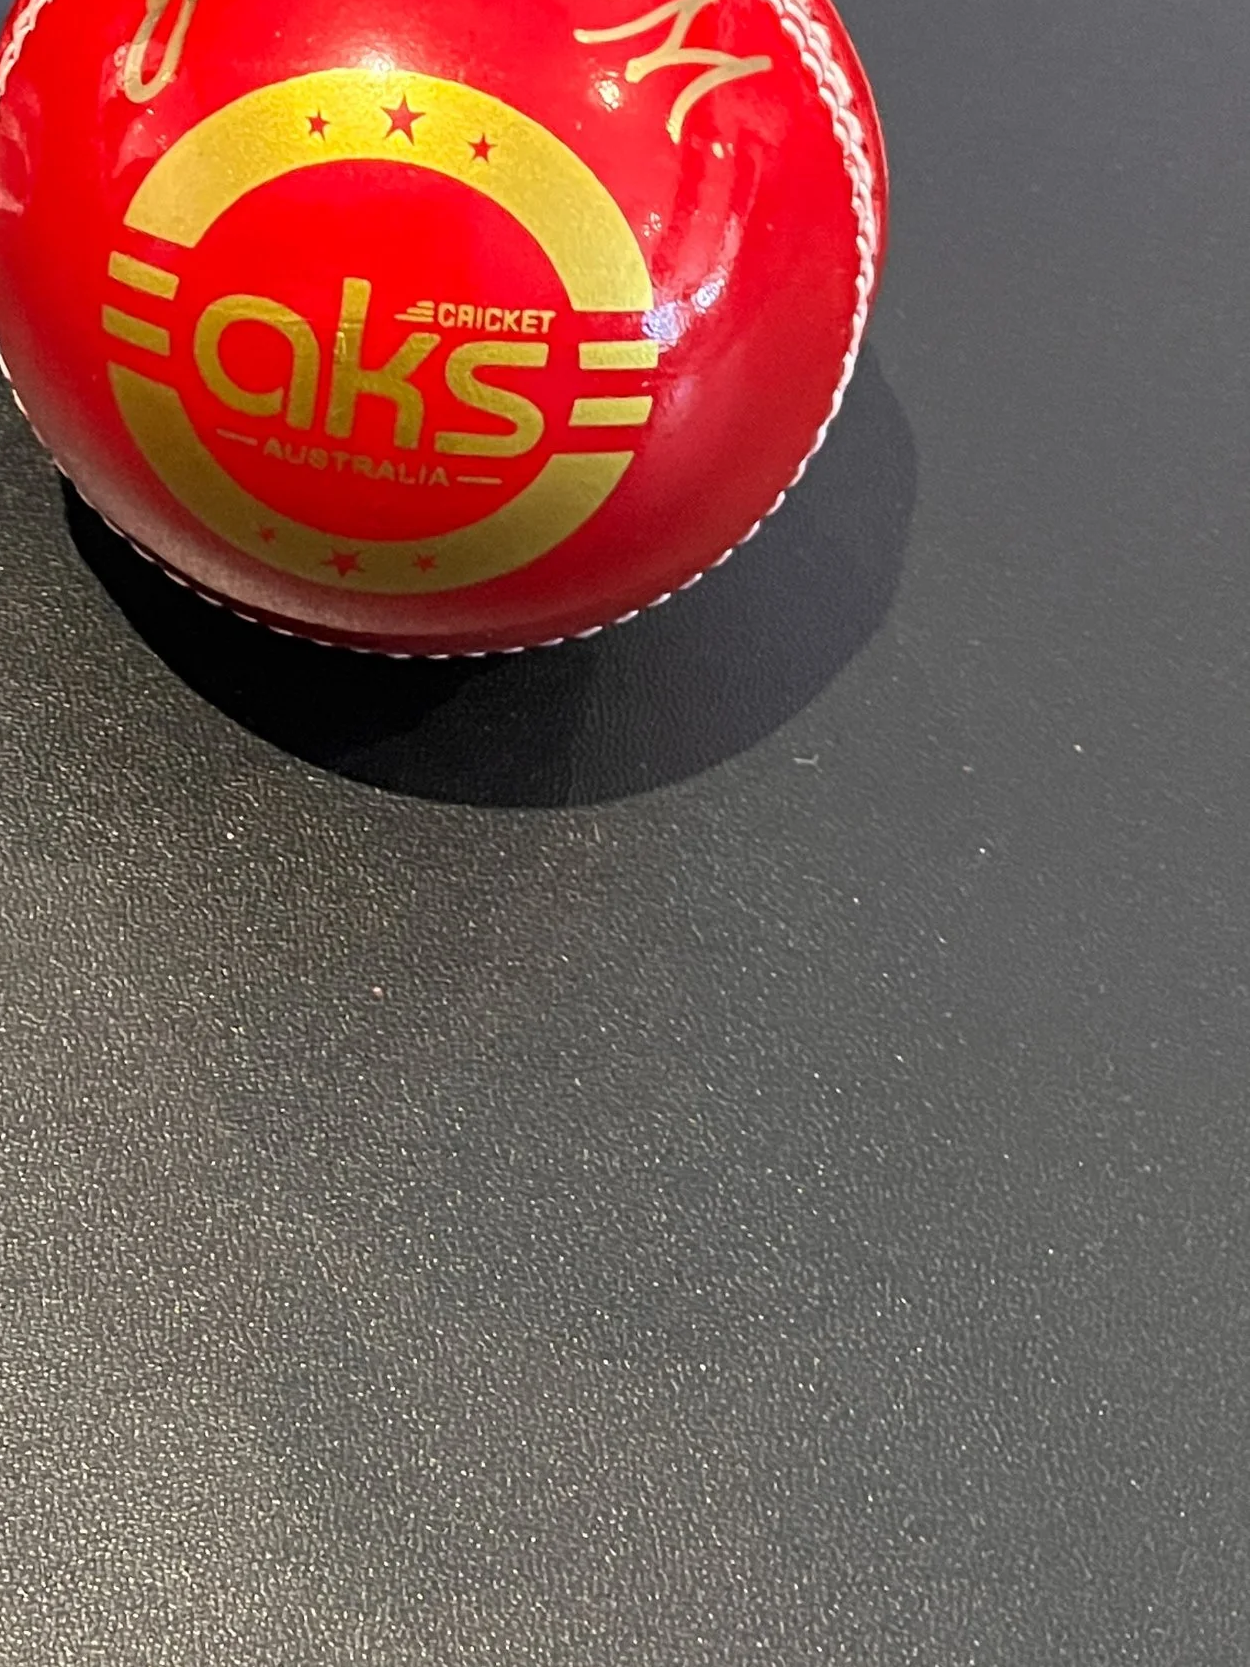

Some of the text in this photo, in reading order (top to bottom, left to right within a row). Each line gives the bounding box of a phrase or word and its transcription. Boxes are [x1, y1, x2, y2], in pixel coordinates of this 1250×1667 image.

[437, 303, 557, 334] CRICKET
[194, 277, 549, 458] aks
[263, 438, 450, 487] AUSTRALIA
